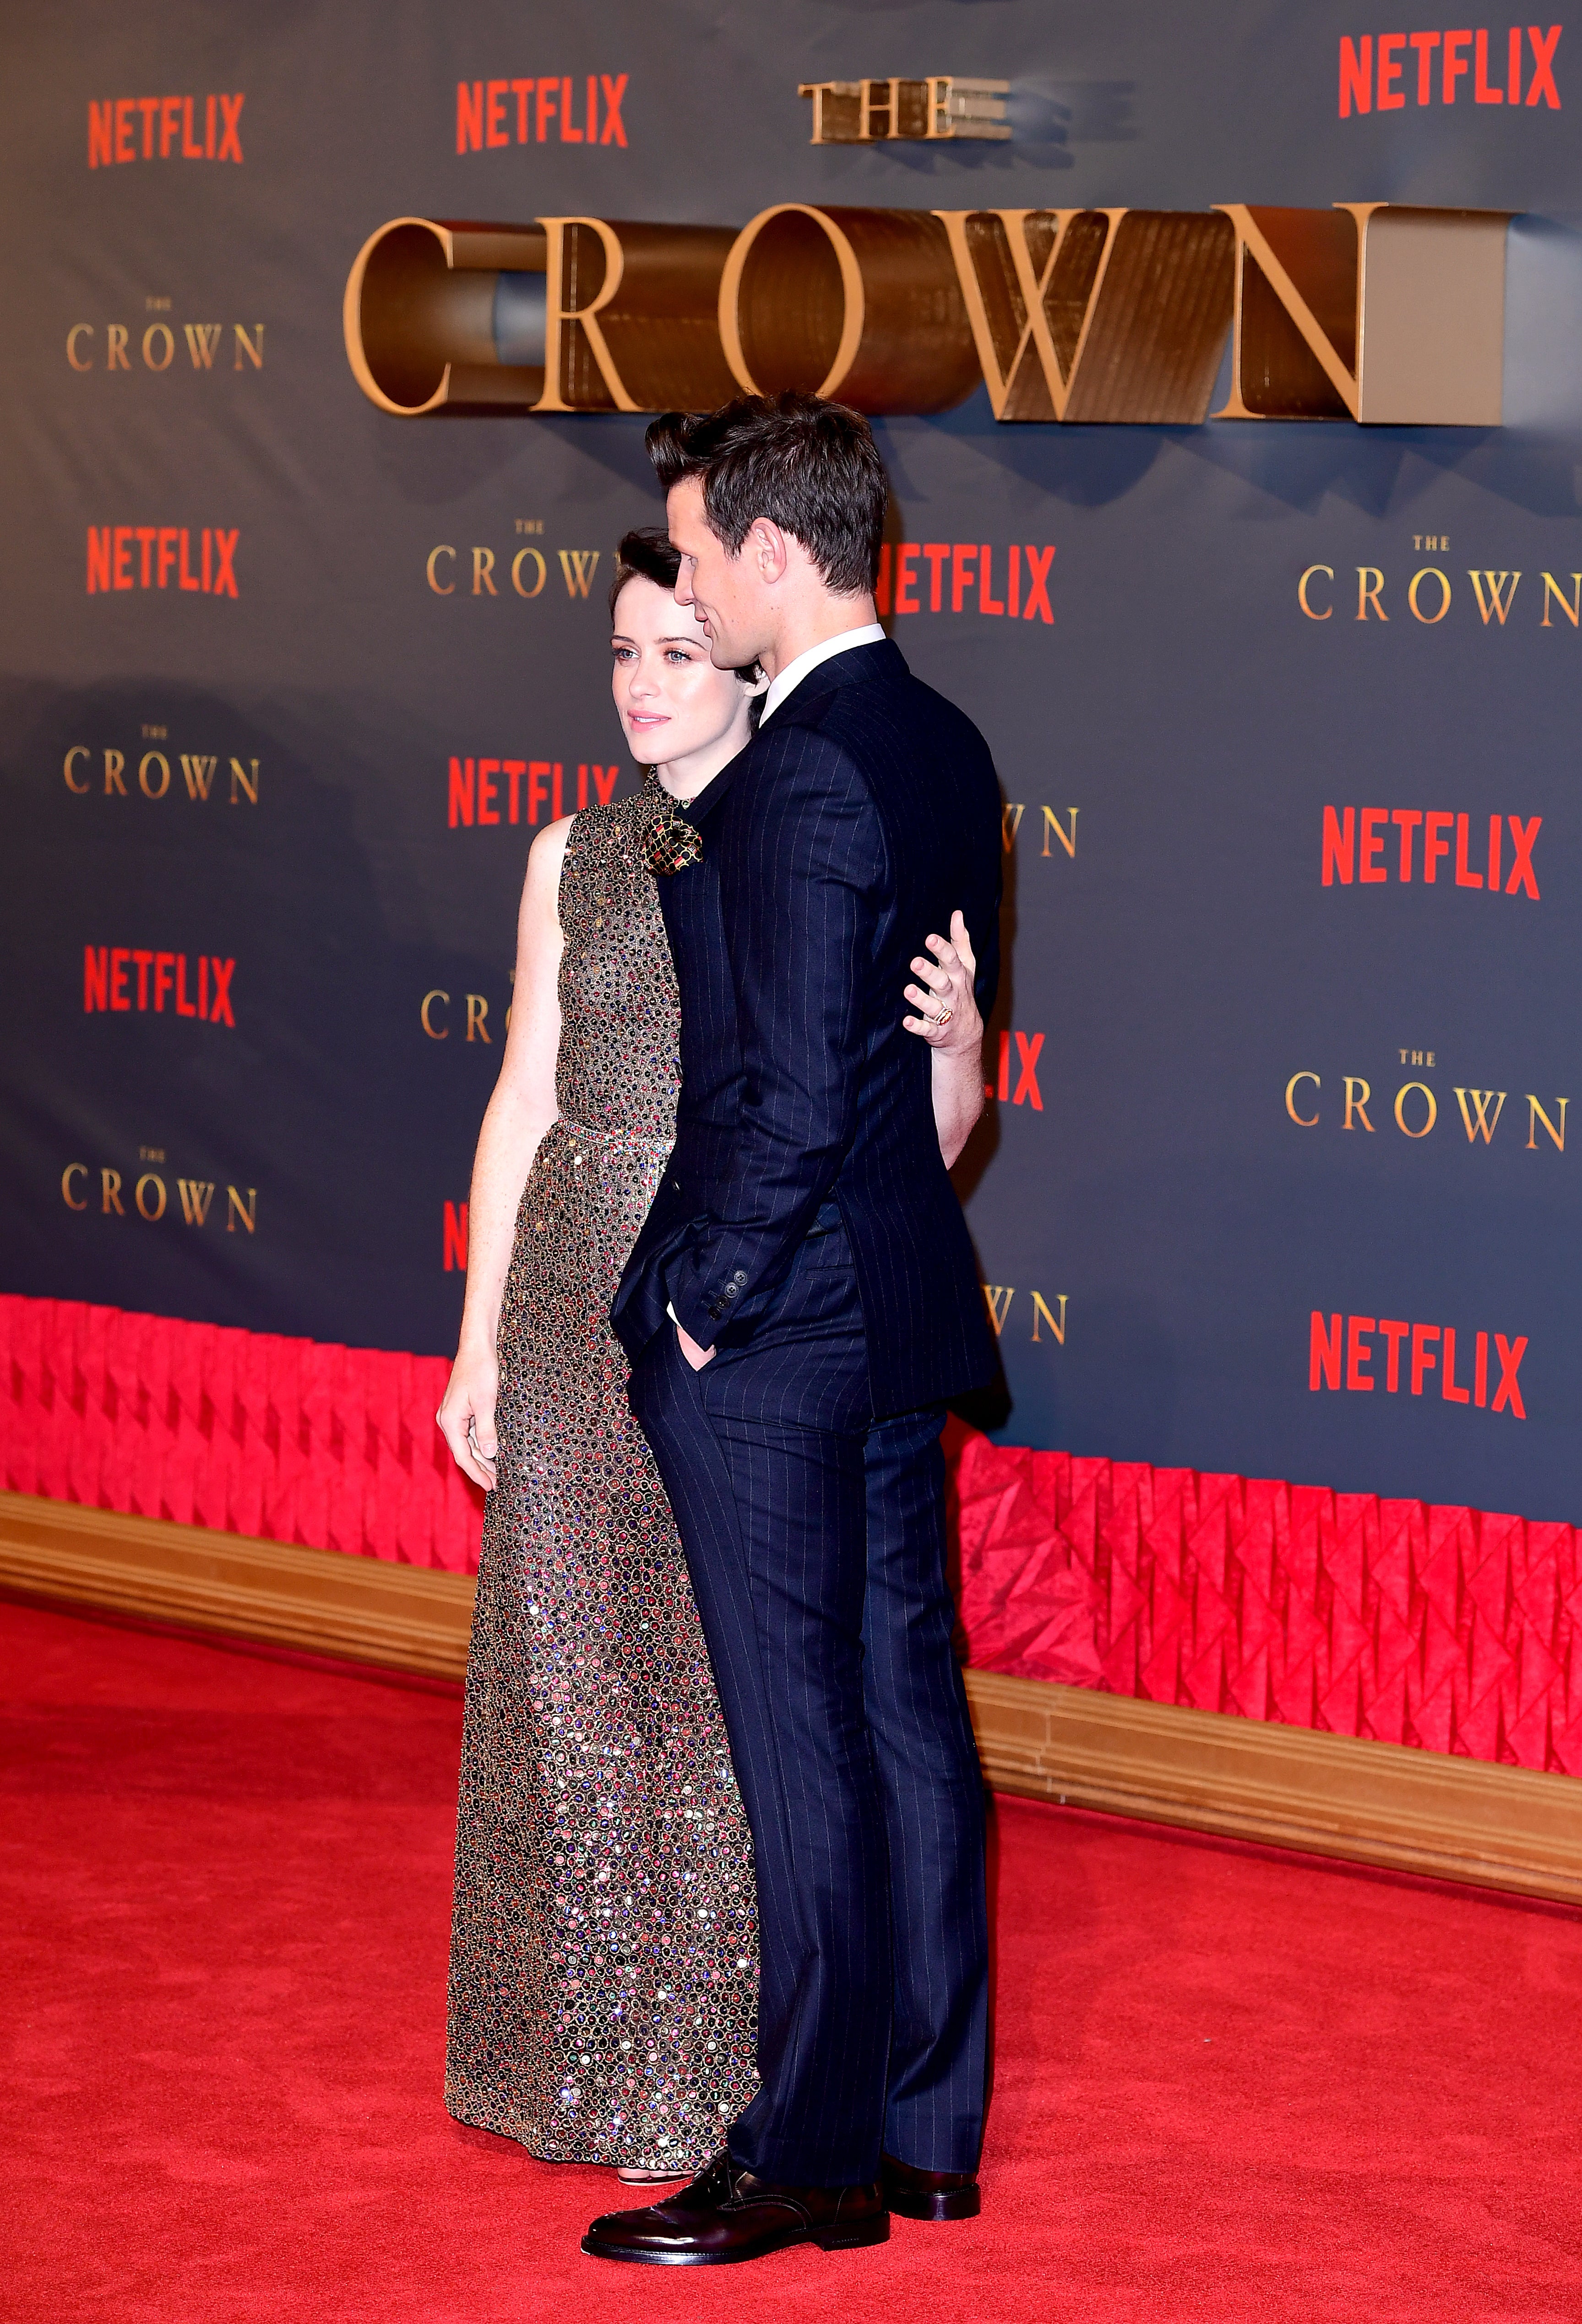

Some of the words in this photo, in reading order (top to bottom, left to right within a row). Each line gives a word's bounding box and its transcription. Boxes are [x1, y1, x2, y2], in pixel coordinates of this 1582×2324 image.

[1339, 25, 1562, 118] NETFLIX
[88, 93, 245, 168] NETFLIX
[457, 73, 629, 154] NETFLIX
[798, 76, 956, 145] THE
[66, 322, 266, 372] CROWN
[343, 201, 1389, 423] CROWN
[87, 525, 239, 598] NETFLIX
[426, 545, 621, 598] CROW
[1413, 535, 1449, 551] THE
[1298, 564, 1582, 627] CROWN
[63, 746, 261, 804] CROWN
[1321, 805, 1542, 900] NETFLIX
[84, 945, 236, 1027] NETFLIX
[1399, 1049, 1436, 1067] THE
[1285, 1070, 1570, 1151] CROWN
[61, 1163, 257, 1233] CROWN
[1309, 1310, 1528, 1419] NETFLIX
